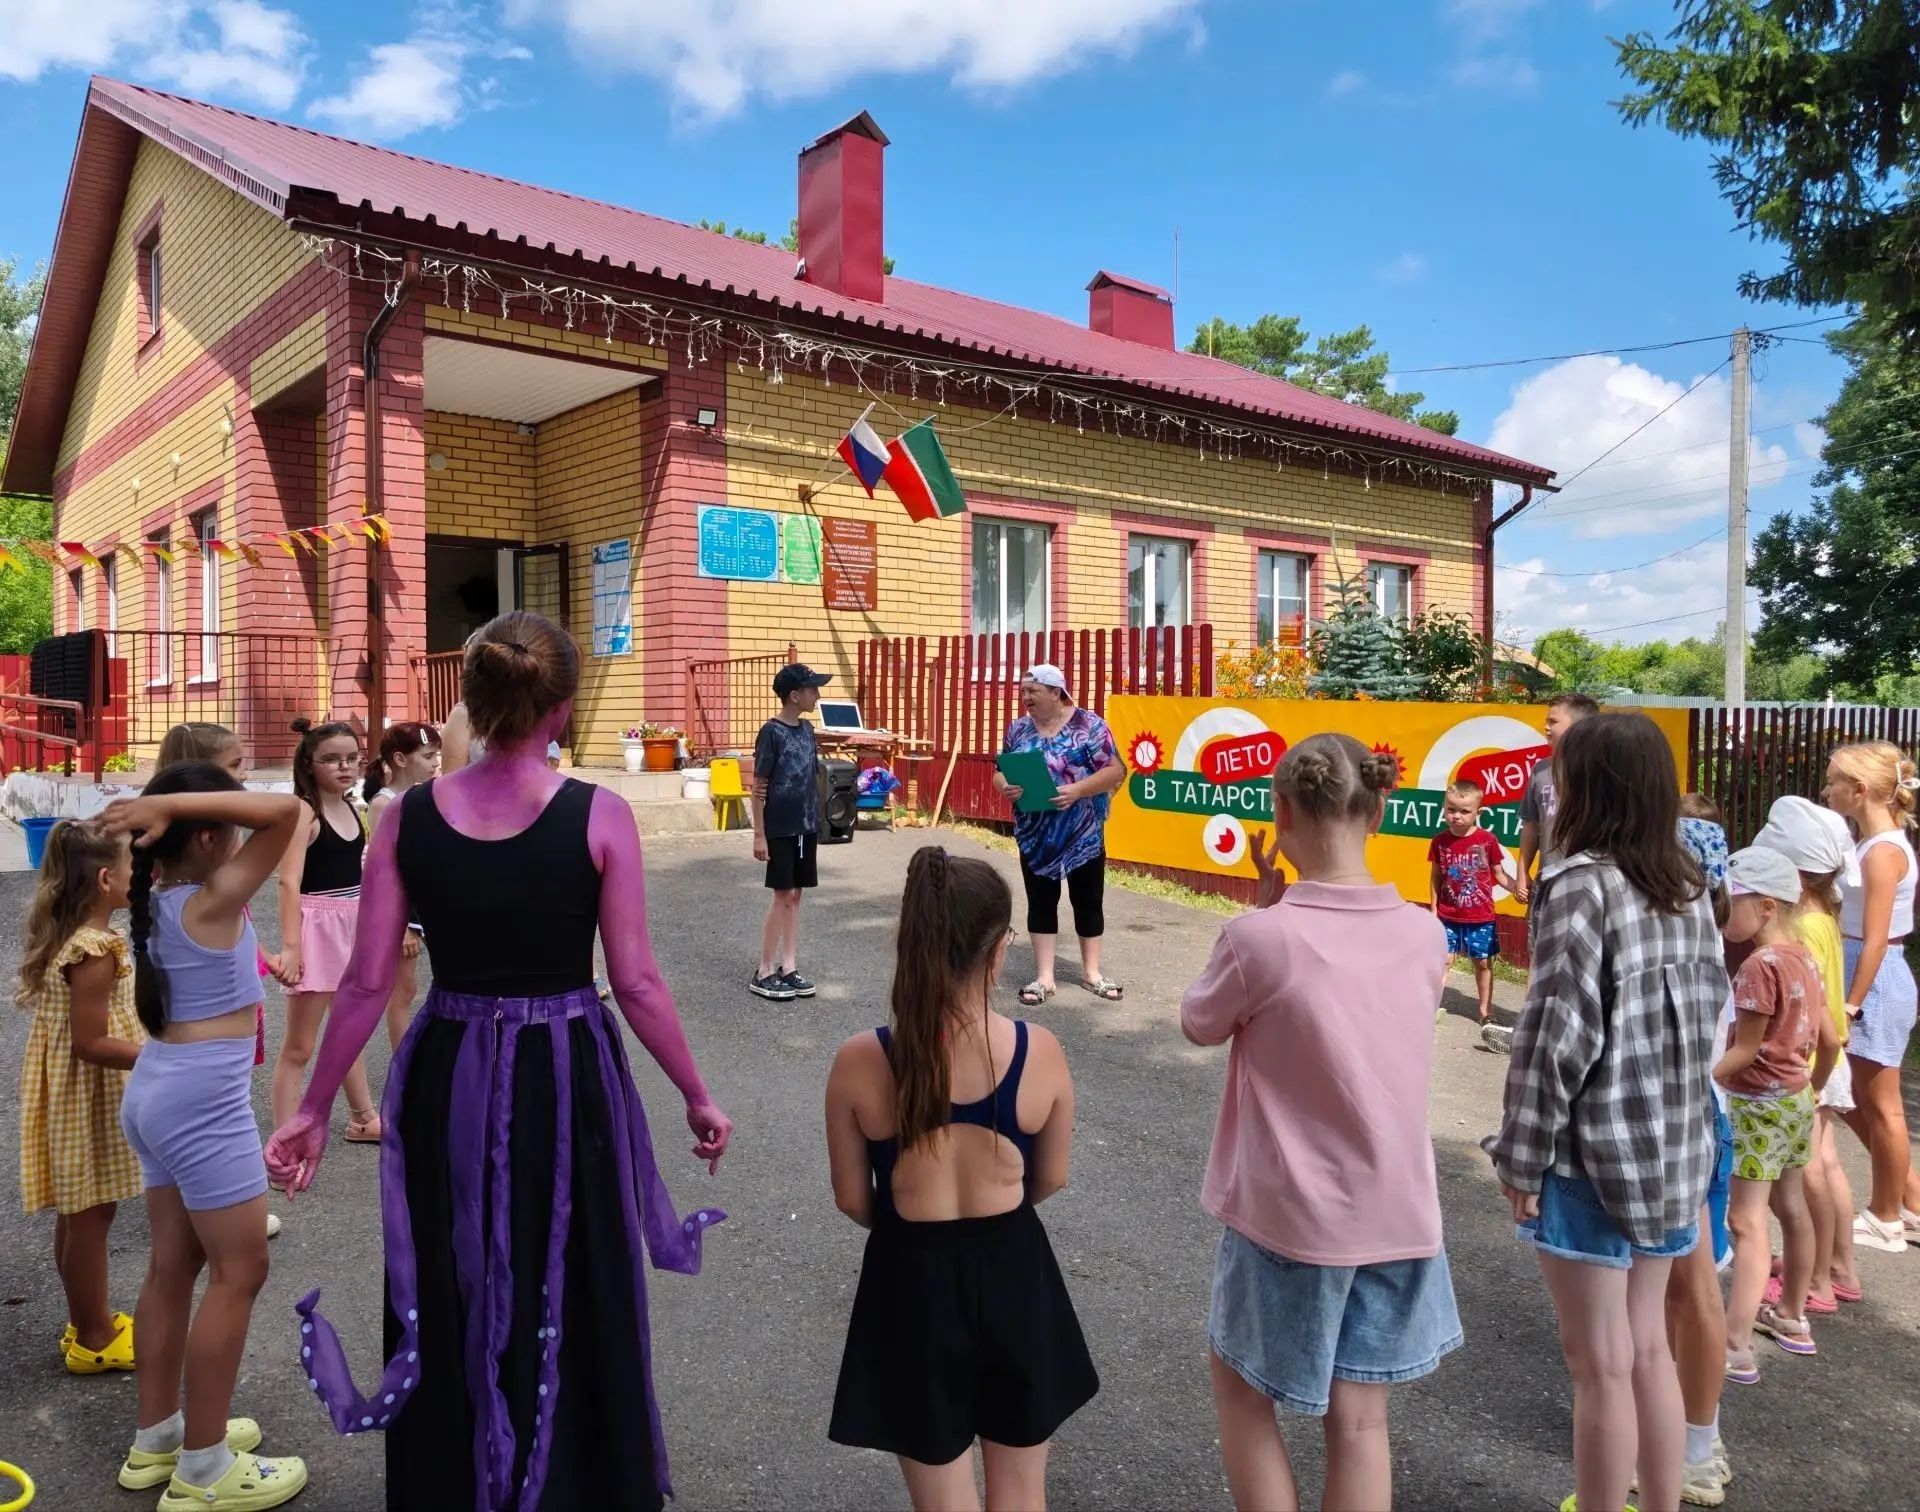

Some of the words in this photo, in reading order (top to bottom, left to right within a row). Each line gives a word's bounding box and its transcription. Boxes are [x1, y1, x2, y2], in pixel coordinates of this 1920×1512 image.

[1215, 742, 1272, 774] ЛЕТО
[1144, 778, 1156, 800] В
[1171, 780, 1275, 812] ТАТАРСТ
